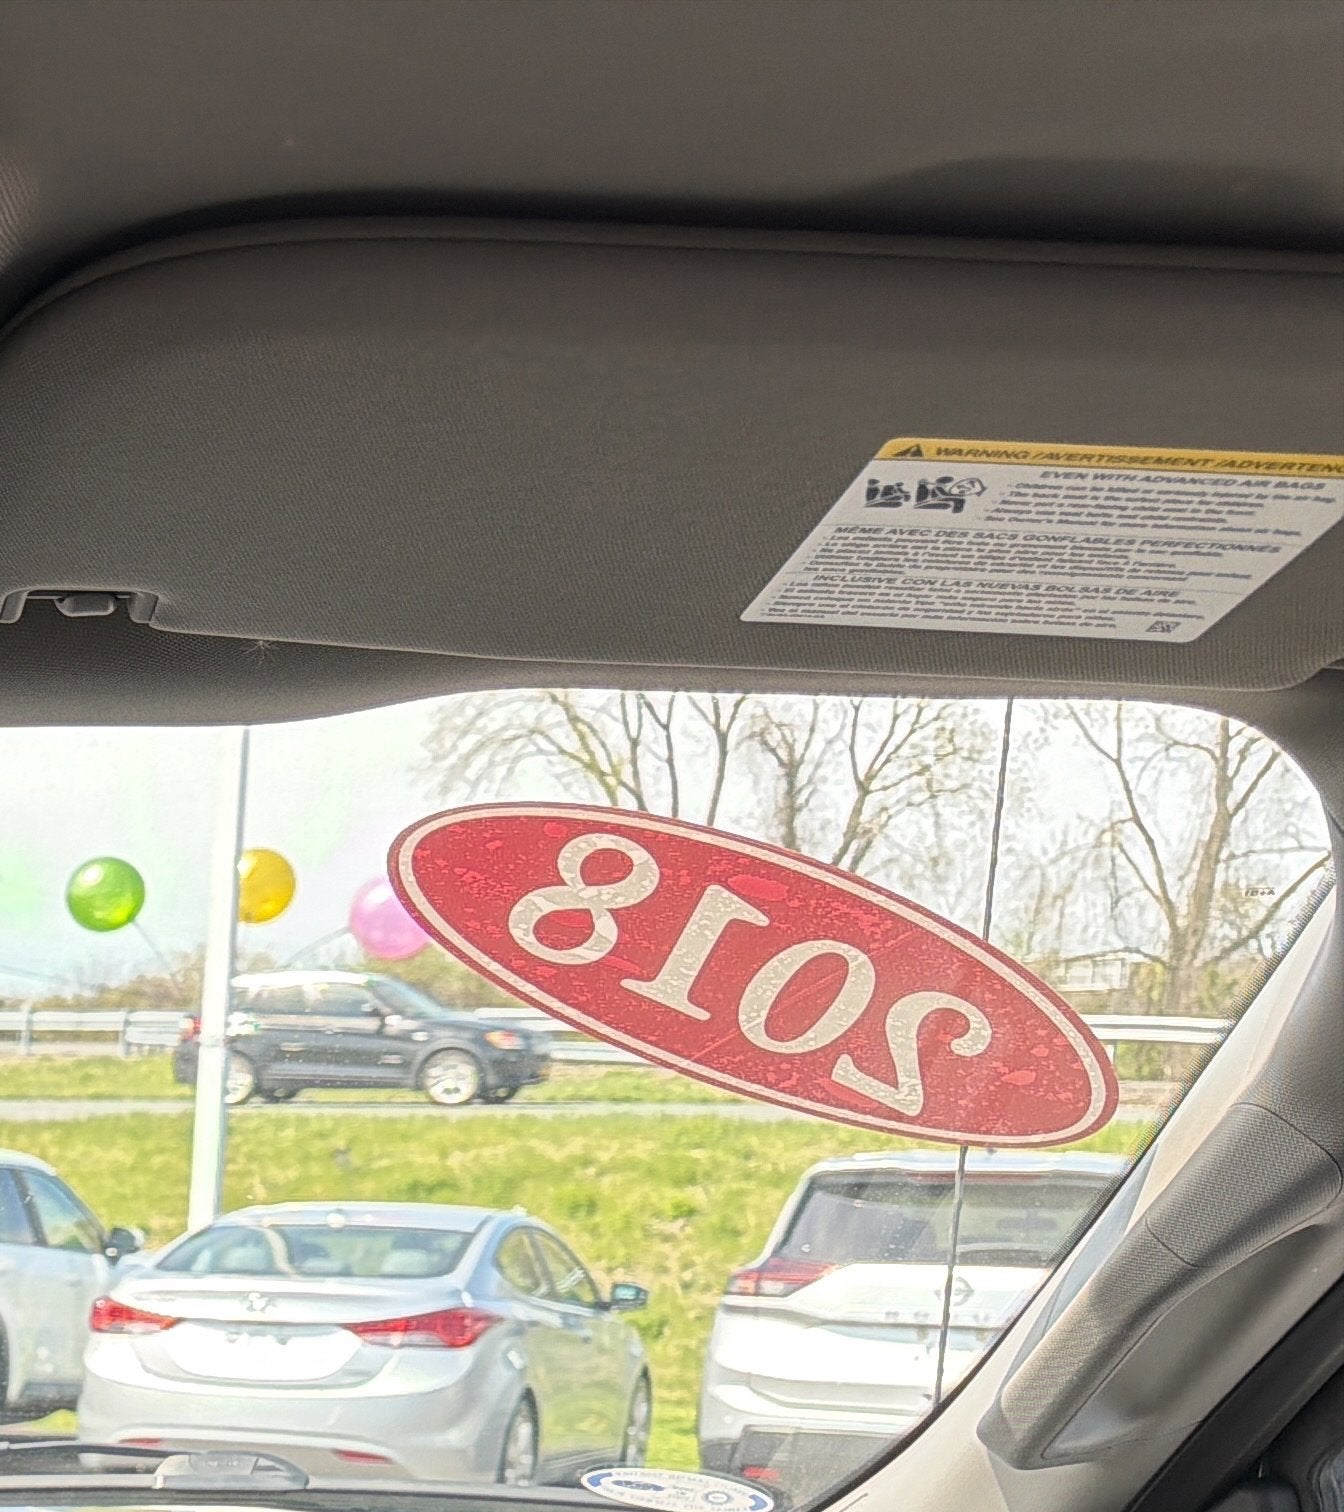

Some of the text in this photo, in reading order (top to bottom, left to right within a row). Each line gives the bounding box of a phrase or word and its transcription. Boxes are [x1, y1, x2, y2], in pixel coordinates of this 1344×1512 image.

[936, 447, 1029, 460] WARNING
[1040, 471, 1326, 490] EVEN WITH ADVANCED AIR BAGS
